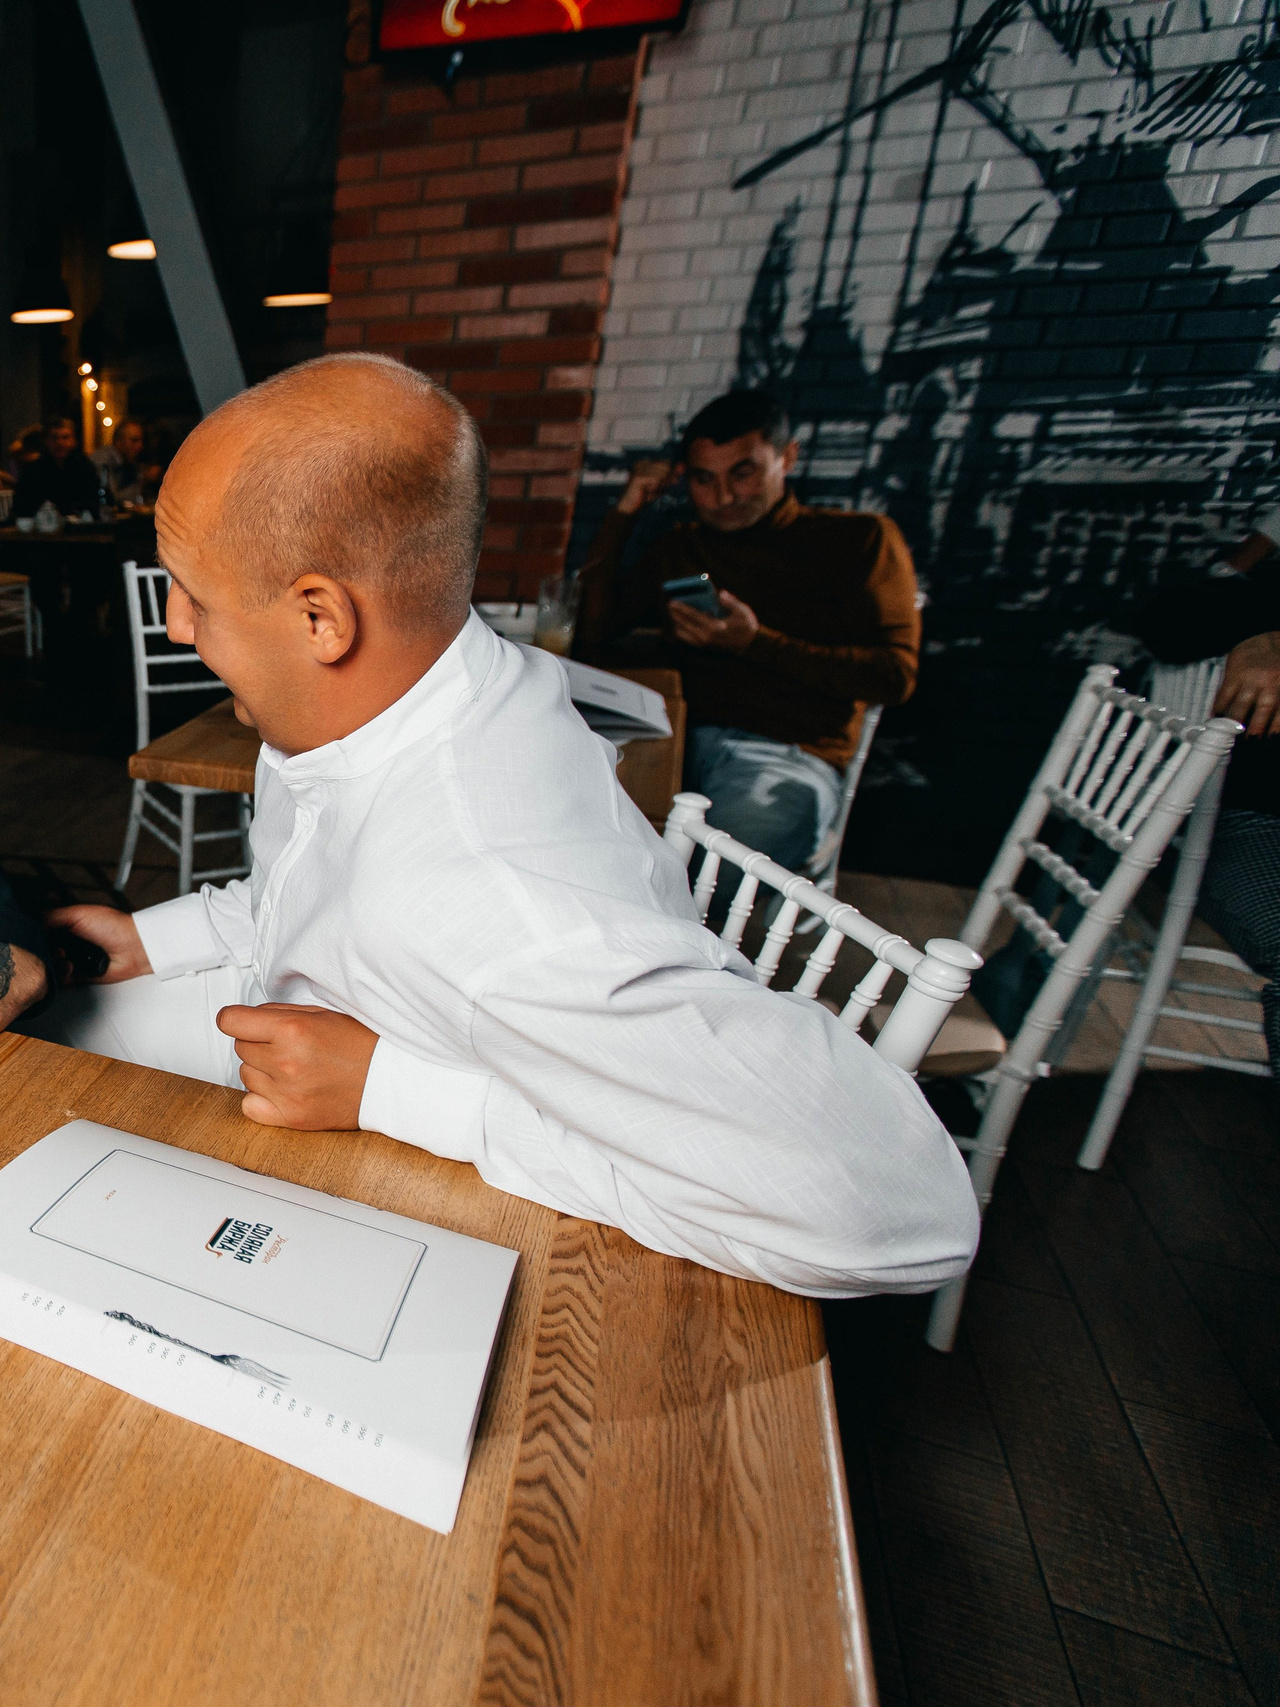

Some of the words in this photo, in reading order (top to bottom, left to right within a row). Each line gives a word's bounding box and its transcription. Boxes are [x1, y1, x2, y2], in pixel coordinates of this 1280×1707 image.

[216, 1220, 252, 1252] БИРЖА
[233, 1223, 273, 1264] СОЛЯНАЯ
[262, 1235, 288, 1264] Ресторан
[128, 1334, 137, 1346] 560
[147, 1342, 156, 1354] 620
[161, 1348, 170, 1360] 590
[176, 1354, 186, 1367] 650
[257, 1386, 267, 1399] 540
[272, 1393, 281, 1405] 420
[303, 1406, 312, 1418] 510
[341, 1420, 351, 1434] 560
[374, 1433, 383, 1447] 1120
